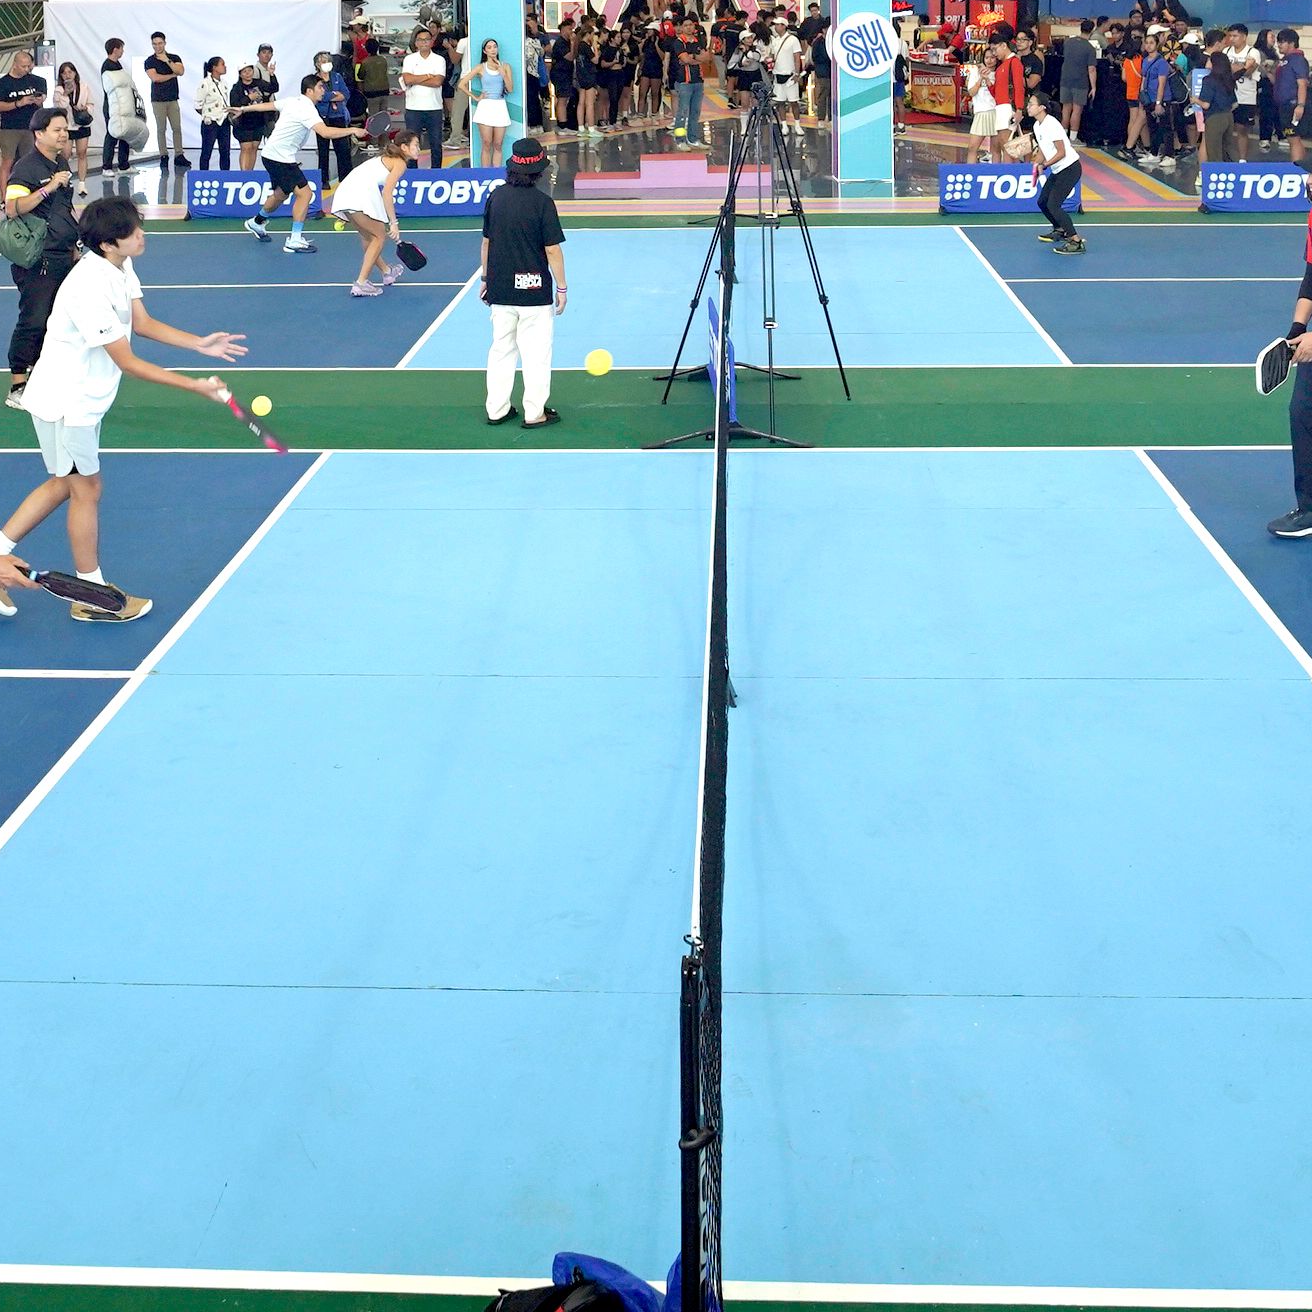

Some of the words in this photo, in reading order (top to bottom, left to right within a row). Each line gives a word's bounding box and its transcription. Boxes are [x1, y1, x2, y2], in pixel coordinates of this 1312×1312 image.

[840, 19, 894, 67] SM
[412, 180, 506, 205] TOBYS
[977, 174, 1075, 200] TOB
[1239, 174, 1309, 199] TOB
